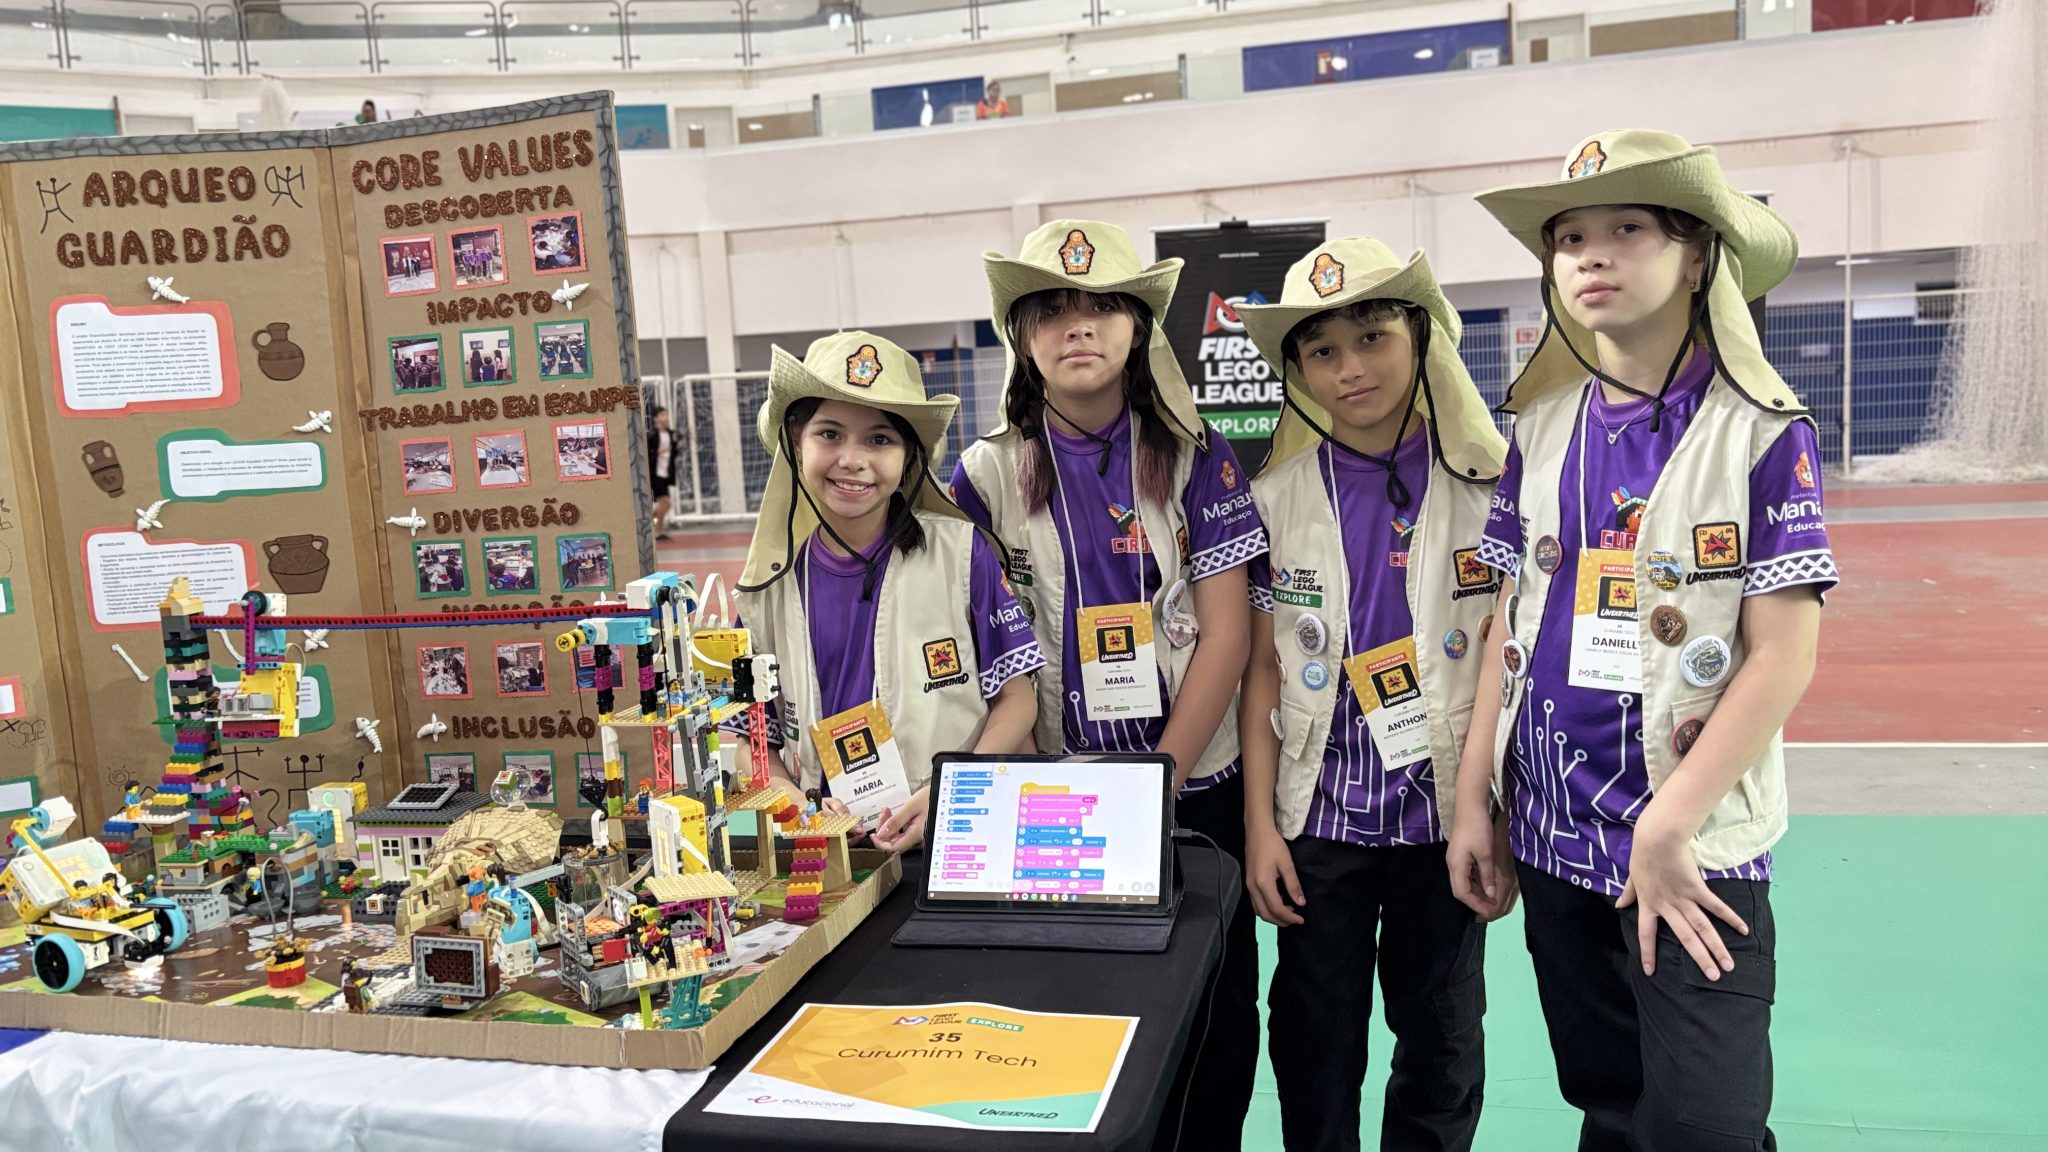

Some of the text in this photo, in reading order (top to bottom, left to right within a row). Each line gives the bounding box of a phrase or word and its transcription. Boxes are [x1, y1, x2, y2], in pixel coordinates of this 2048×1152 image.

[351, 129, 594, 195] CORE VALUES
[82, 165, 257, 209] ARQUEO
[384, 184, 575, 229] DESCOBERTA
[56, 214, 292, 268] GUARDIÃO
[426, 289, 554, 326] IMPACTO
[1198, 336, 1260, 361] FIRS
[1204, 361, 1270, 382] LEGO
[1192, 381, 1284, 404] LEAGUE
[359, 385, 641, 434] TRABALHO EM EQUIPE
[432, 498, 581, 534] DIVERSÃO
[1294, 569, 1317, 577] FIRST
[1603, 565, 1635, 573] PARTICIPA
[1293, 576, 1315, 584] LEGO
[1293, 583, 1323, 593] LEAGUE
[1275, 590, 1312, 605] EXPLORE
[1369, 654, 1405, 670] PARTICIPANTE
[924, 672, 969, 693] UNEARTHED
[1105, 676, 1136, 685] MARIA
[451, 710, 596, 739] INCLUSÃO
[832, 718, 867, 736] PARTICIPANTE
[1388, 712, 1428, 732] ANTHON
[853, 779, 884, 796] MARIA
[970, 1018, 1020, 1031] EXPLORE
[929, 1032, 963, 1042] 35
[838, 1046, 1038, 1068] Curumim Tech
[782, 1098, 855, 1108] educacional
